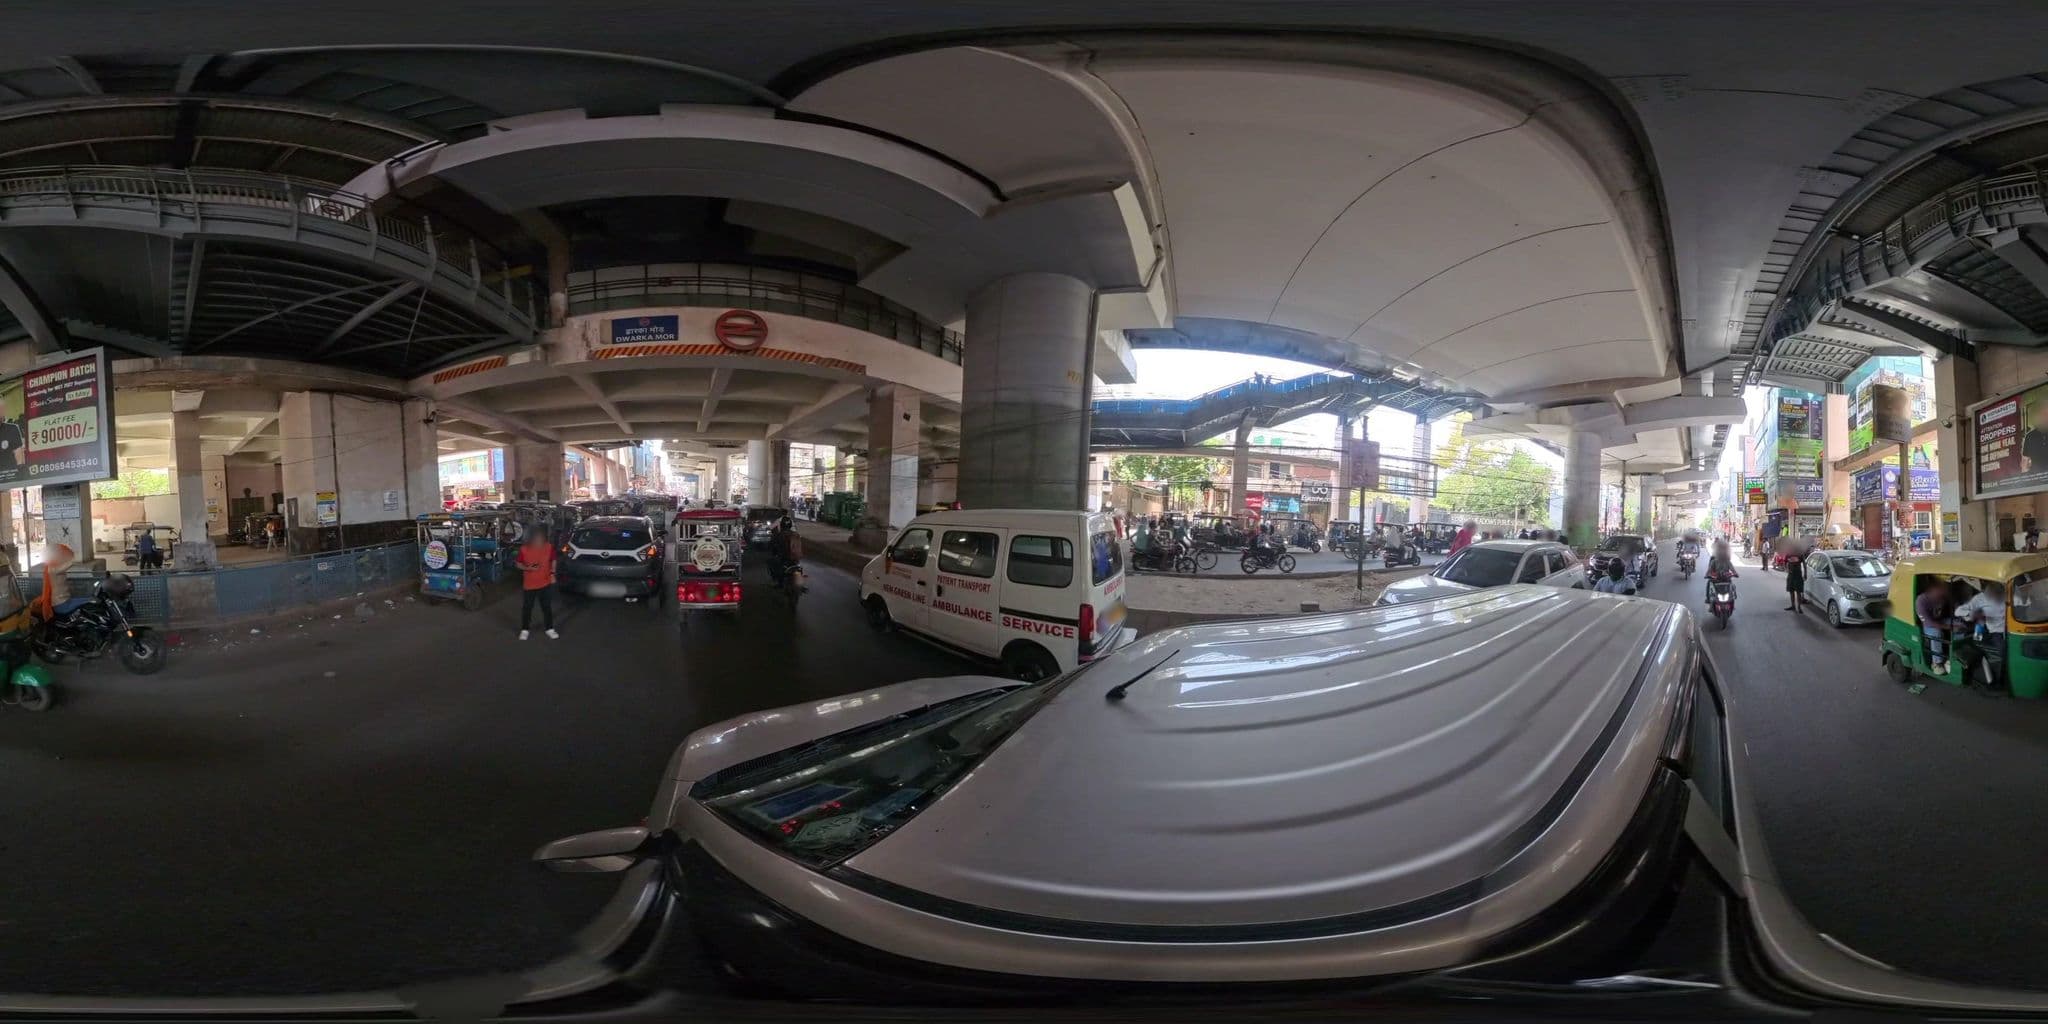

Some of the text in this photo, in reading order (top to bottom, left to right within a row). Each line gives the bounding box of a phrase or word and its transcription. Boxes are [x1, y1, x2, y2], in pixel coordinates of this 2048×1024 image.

[616, 334, 653, 342] DWARKA
[29, 362, 96, 388] CHAMPION BATCH
[44, 414, 76, 425] FLAT FEE
[41, 421, 94, 444] 90000/-
[1980, 424, 2016, 443] DROPPERS
[40, 458, 98, 473] 08069453340
[937, 575, 991, 594] PATIENT TRANSPORT
[912, 591, 927, 605] LINE
[932, 599, 993, 622] AMBULANCE
[1002, 615, 1075, 639] SERVICE
